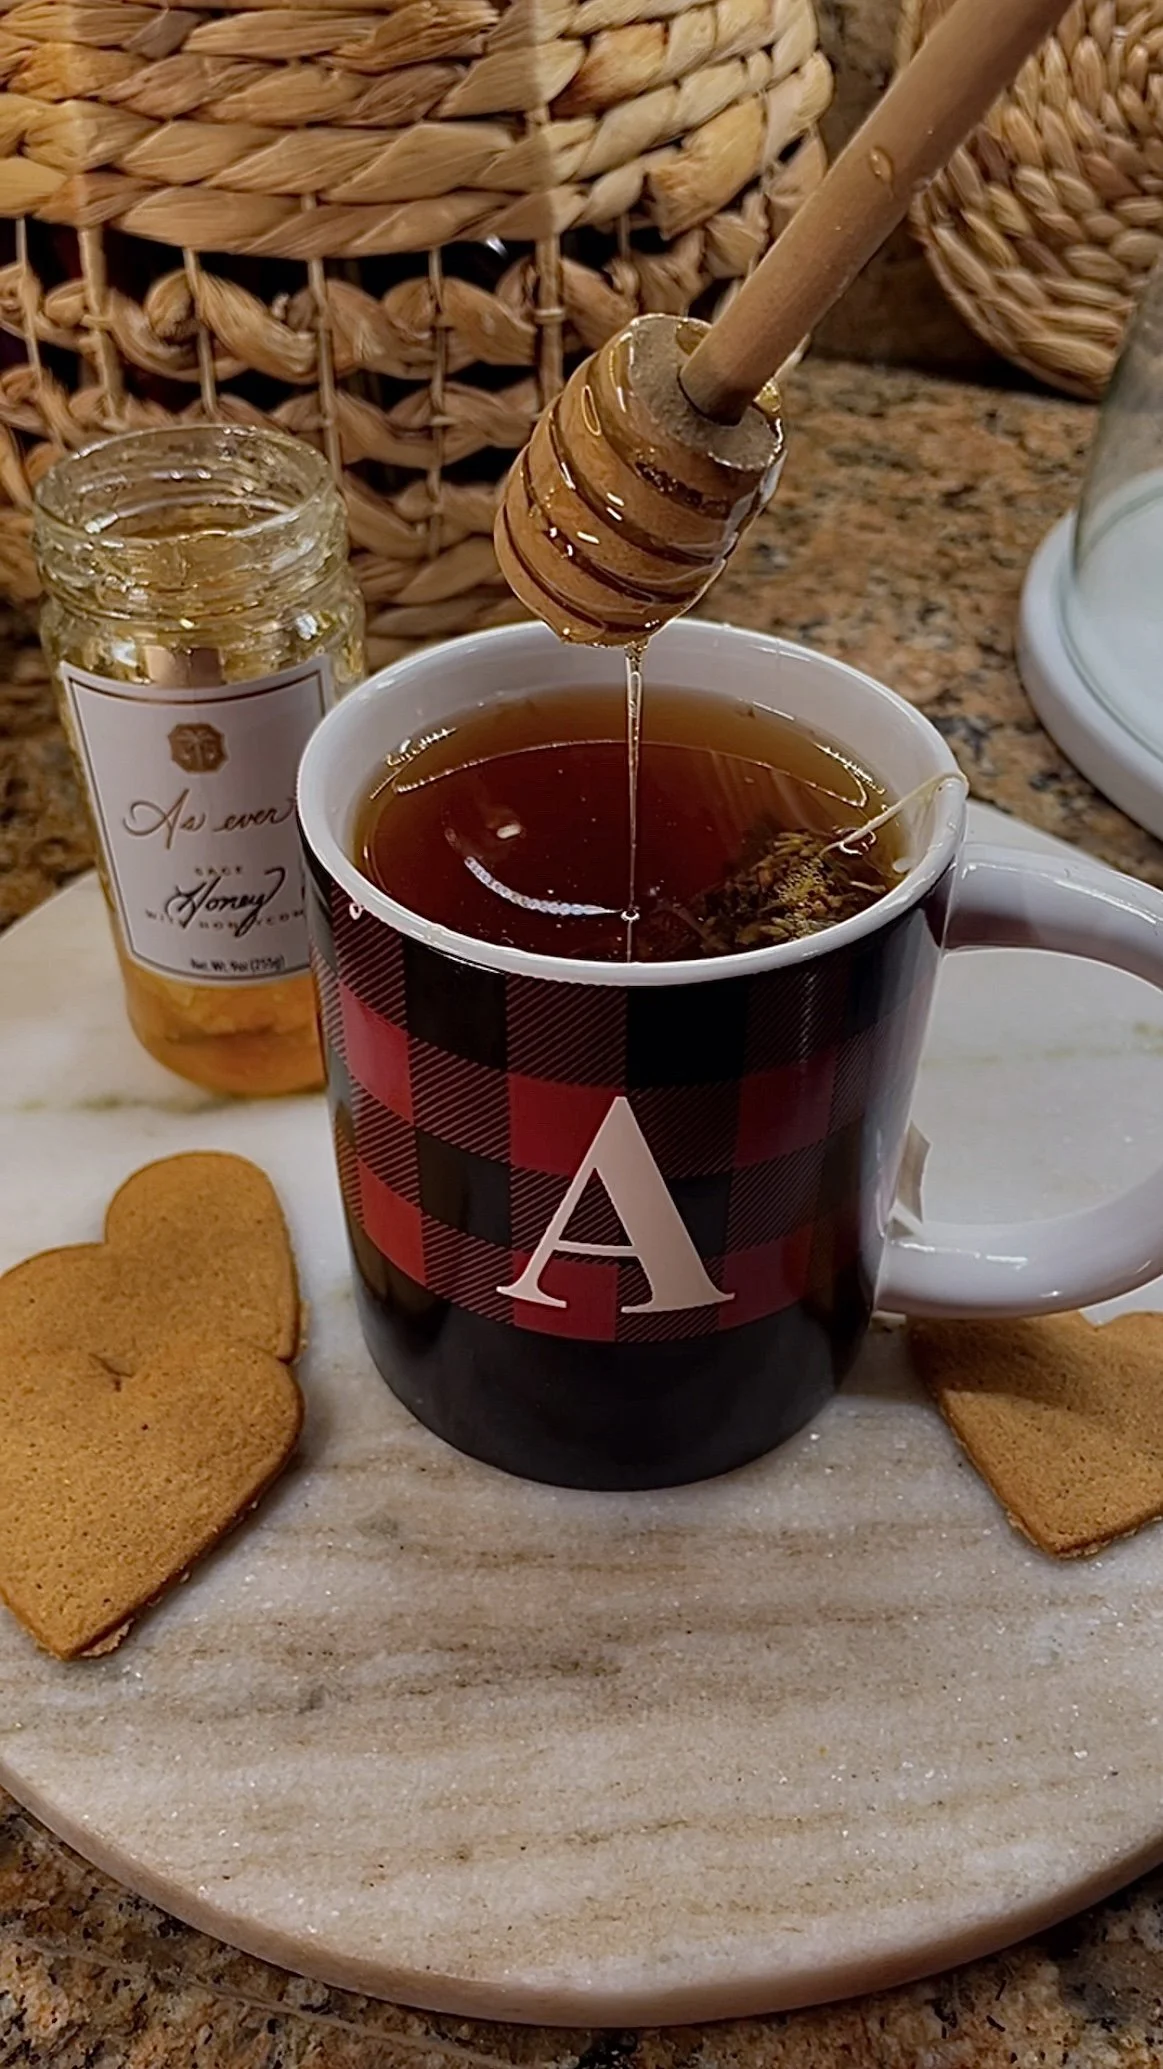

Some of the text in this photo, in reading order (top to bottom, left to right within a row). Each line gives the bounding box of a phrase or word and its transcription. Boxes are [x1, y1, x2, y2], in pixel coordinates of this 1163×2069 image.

[122, 788, 298, 850] As ever
[164, 866, 286, 938] Honey
[496, 1096, 735, 1313] A
